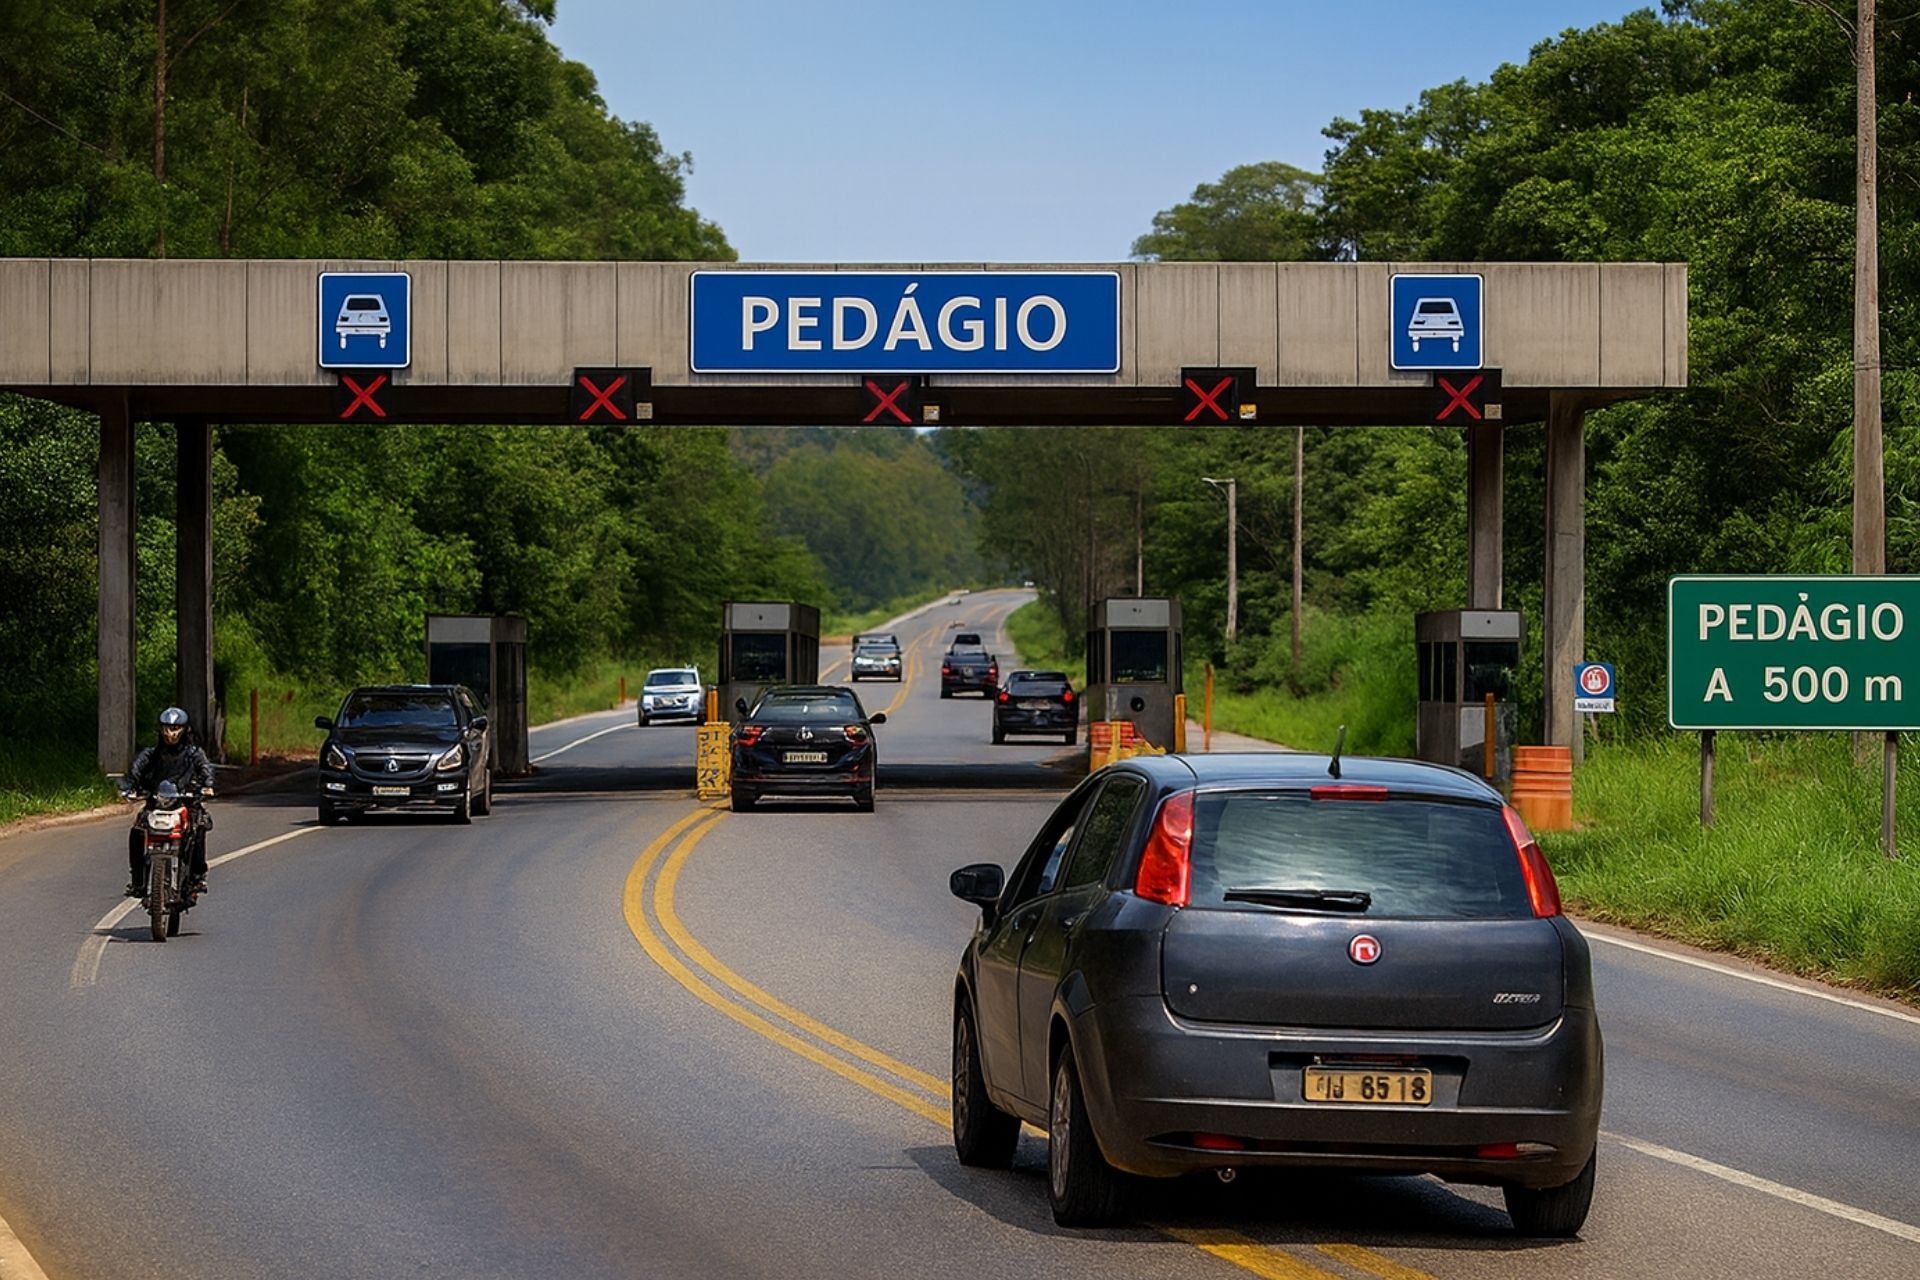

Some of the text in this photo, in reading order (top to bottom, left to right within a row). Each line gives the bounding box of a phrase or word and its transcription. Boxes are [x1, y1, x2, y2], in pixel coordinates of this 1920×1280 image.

[742, 282, 1067, 352] PEDÁGIO
[1703, 666, 1902, 703] A 500 m
